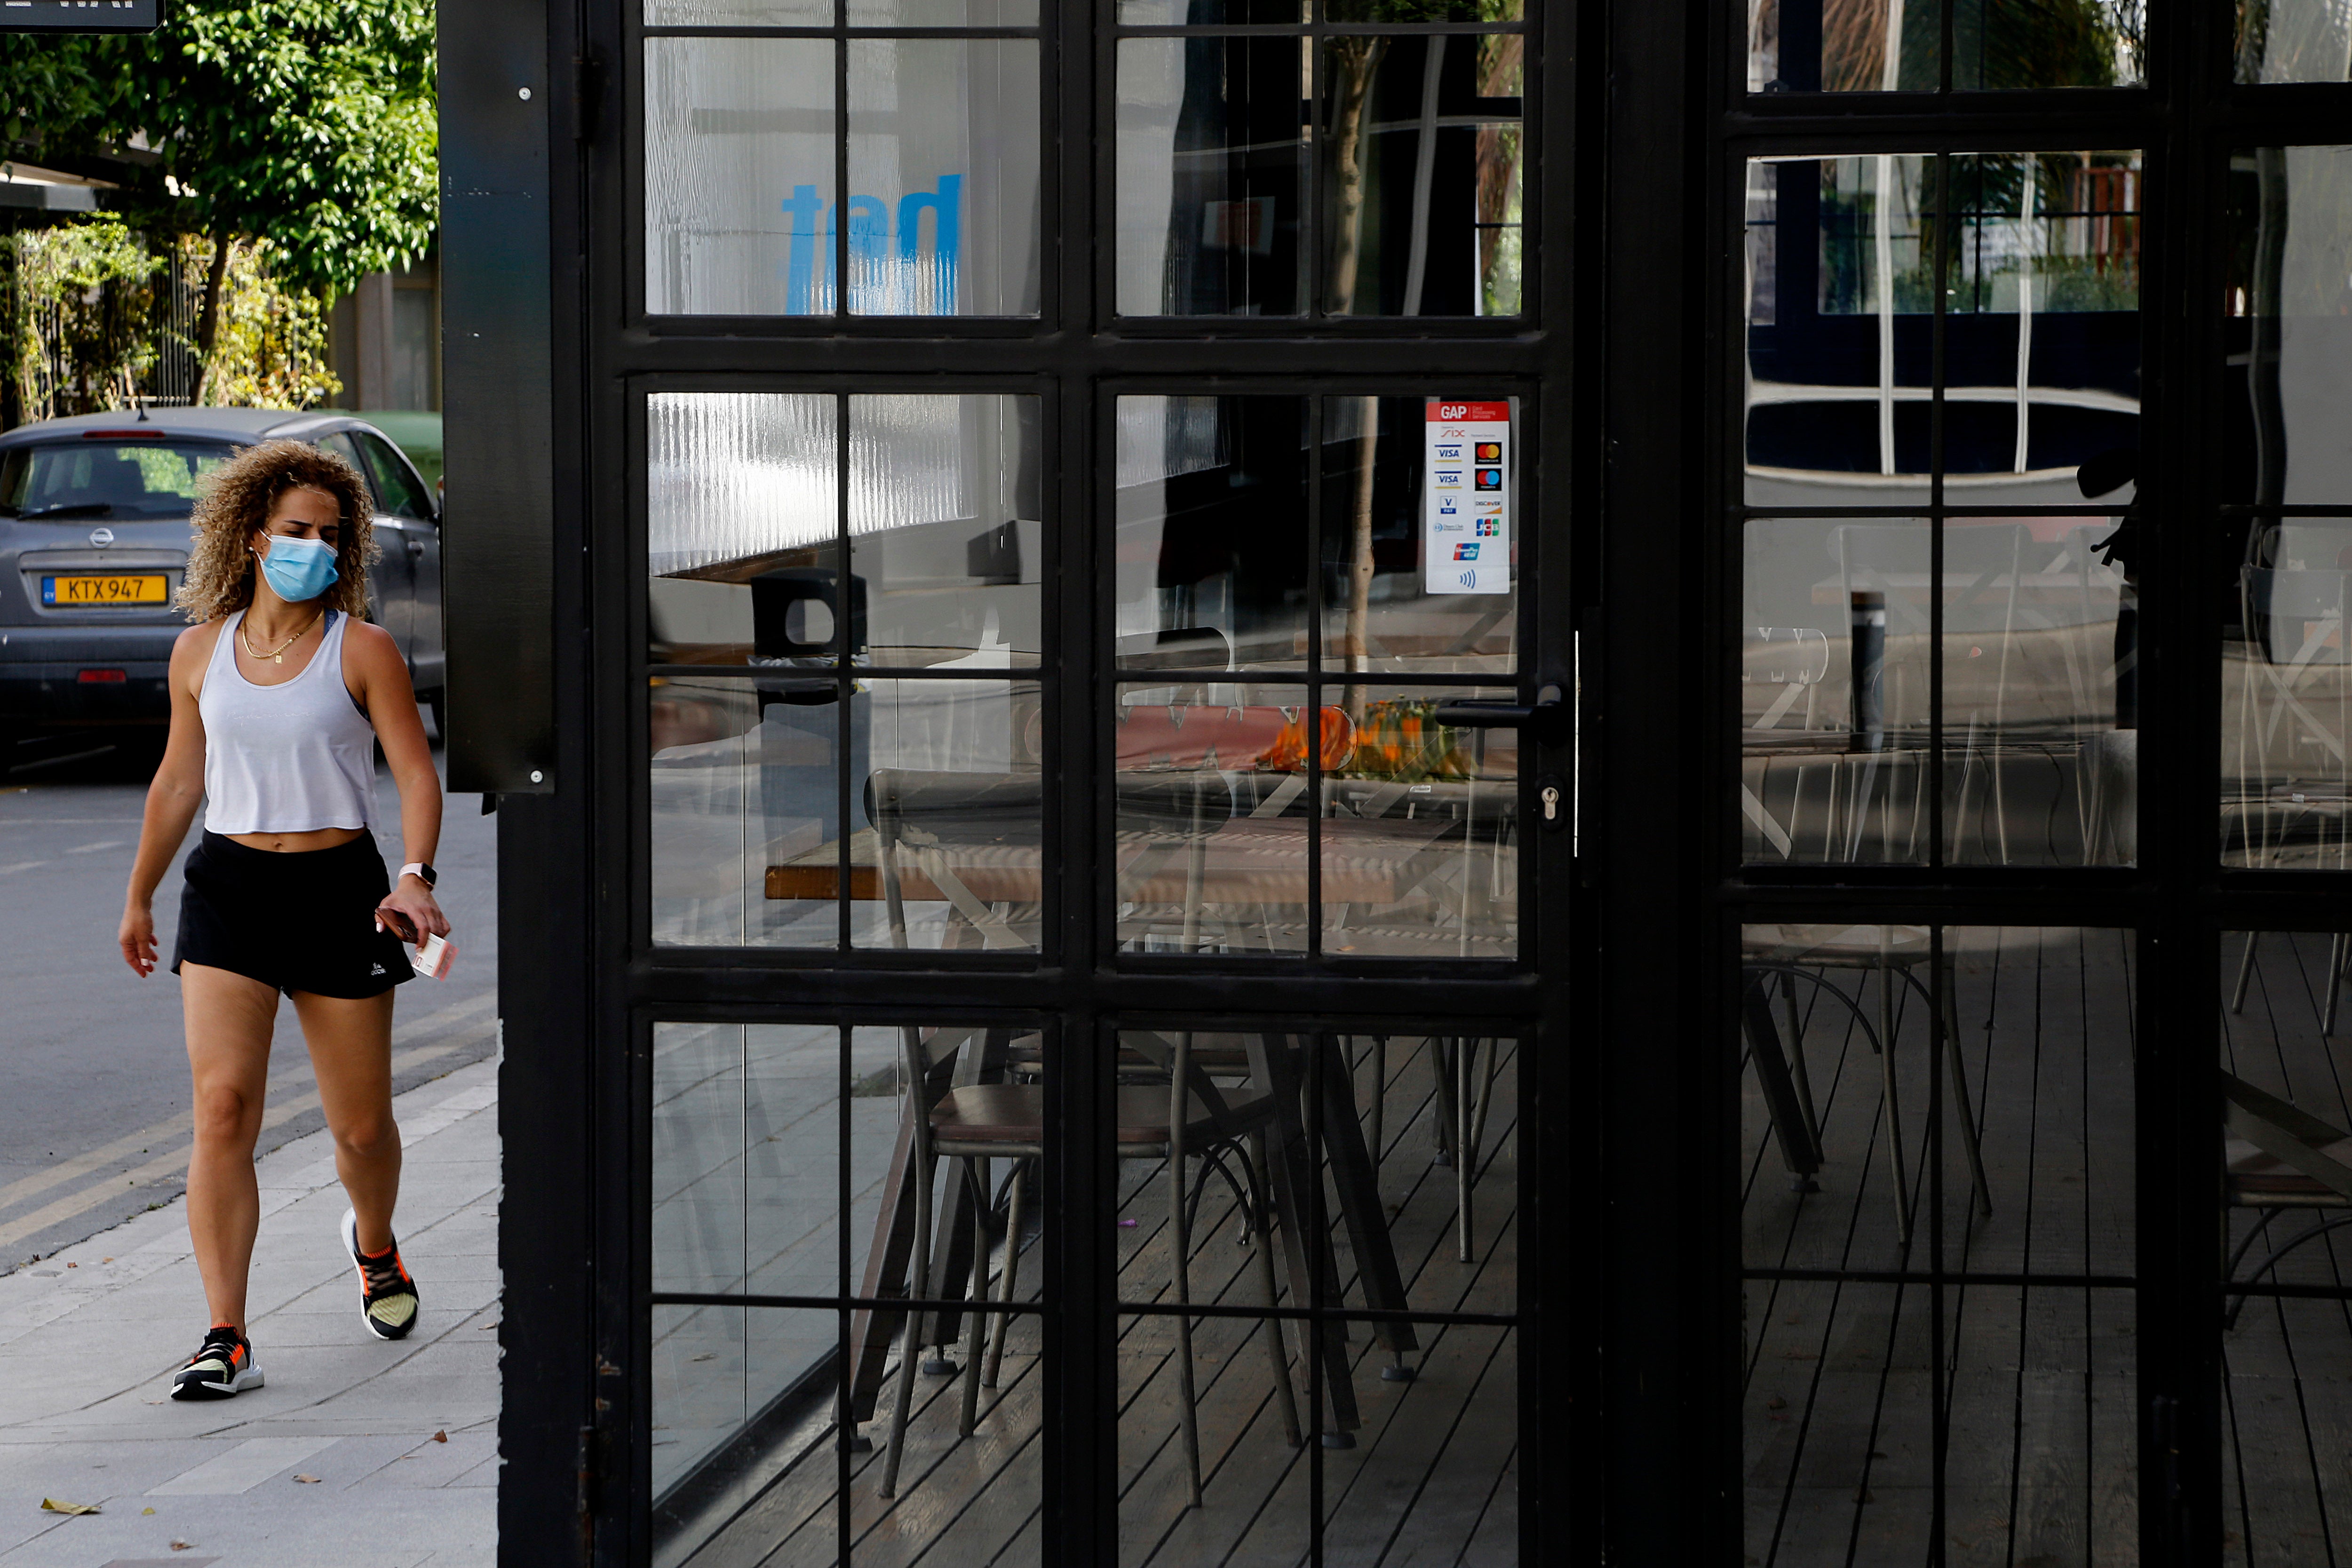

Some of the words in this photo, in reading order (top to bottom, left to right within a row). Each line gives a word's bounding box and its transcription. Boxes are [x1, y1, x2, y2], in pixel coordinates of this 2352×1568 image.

[1441, 406, 1467, 419] GAP
[69, 580, 103, 599] KTX
[108, 579, 143, 598] 947
